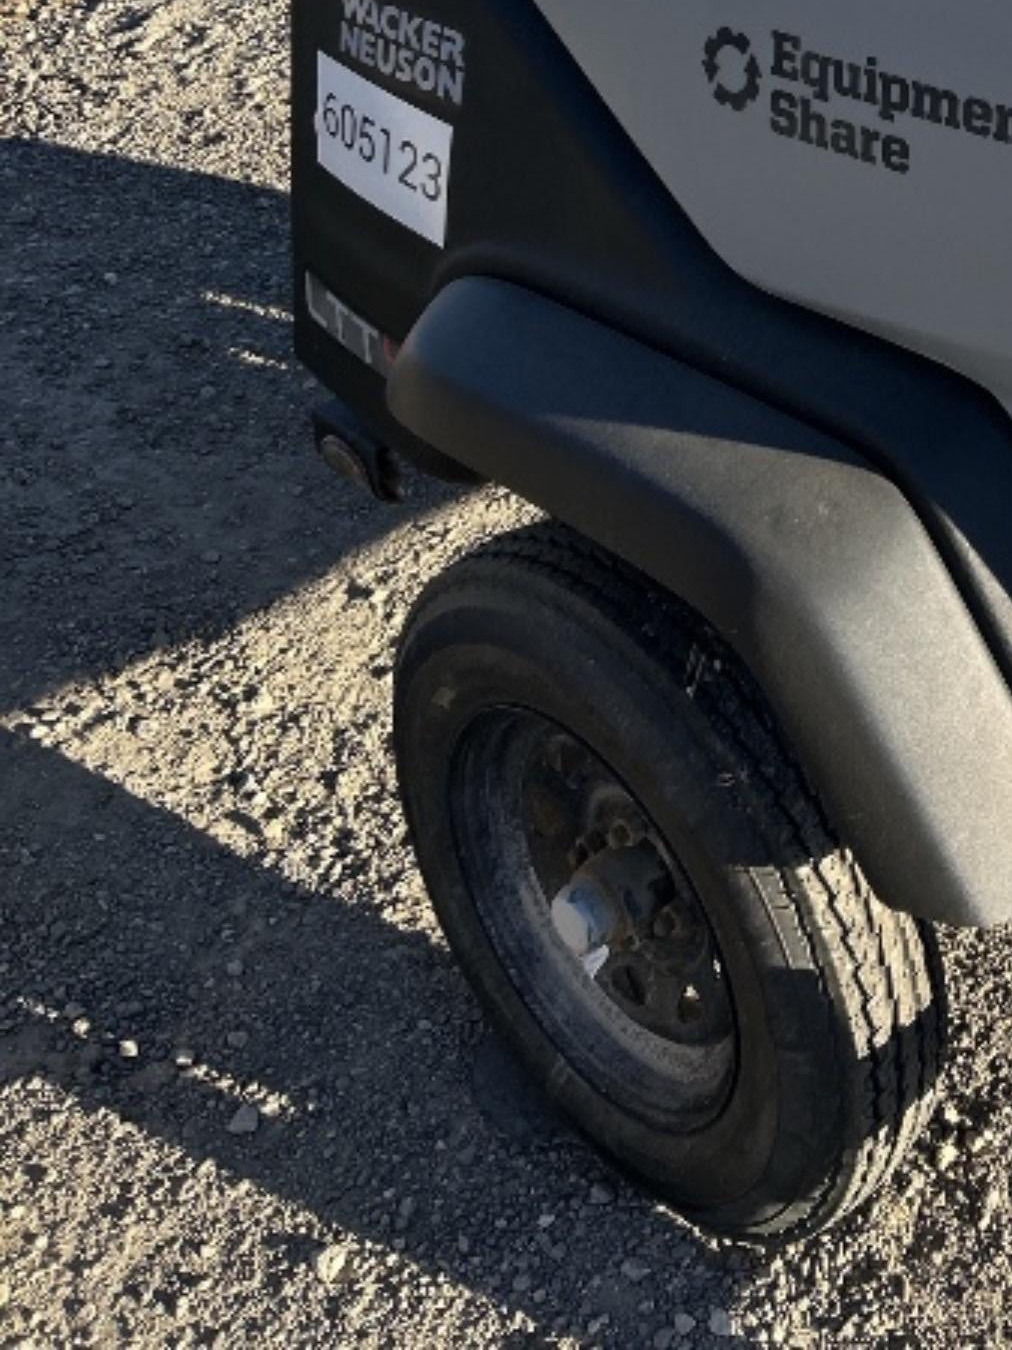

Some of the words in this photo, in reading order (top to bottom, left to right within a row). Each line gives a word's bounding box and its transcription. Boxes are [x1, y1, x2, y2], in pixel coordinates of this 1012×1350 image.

[340, 21, 463, 105] NEUSON
[322, 92, 443, 202] 605123
[770, 89, 910, 174] Share
